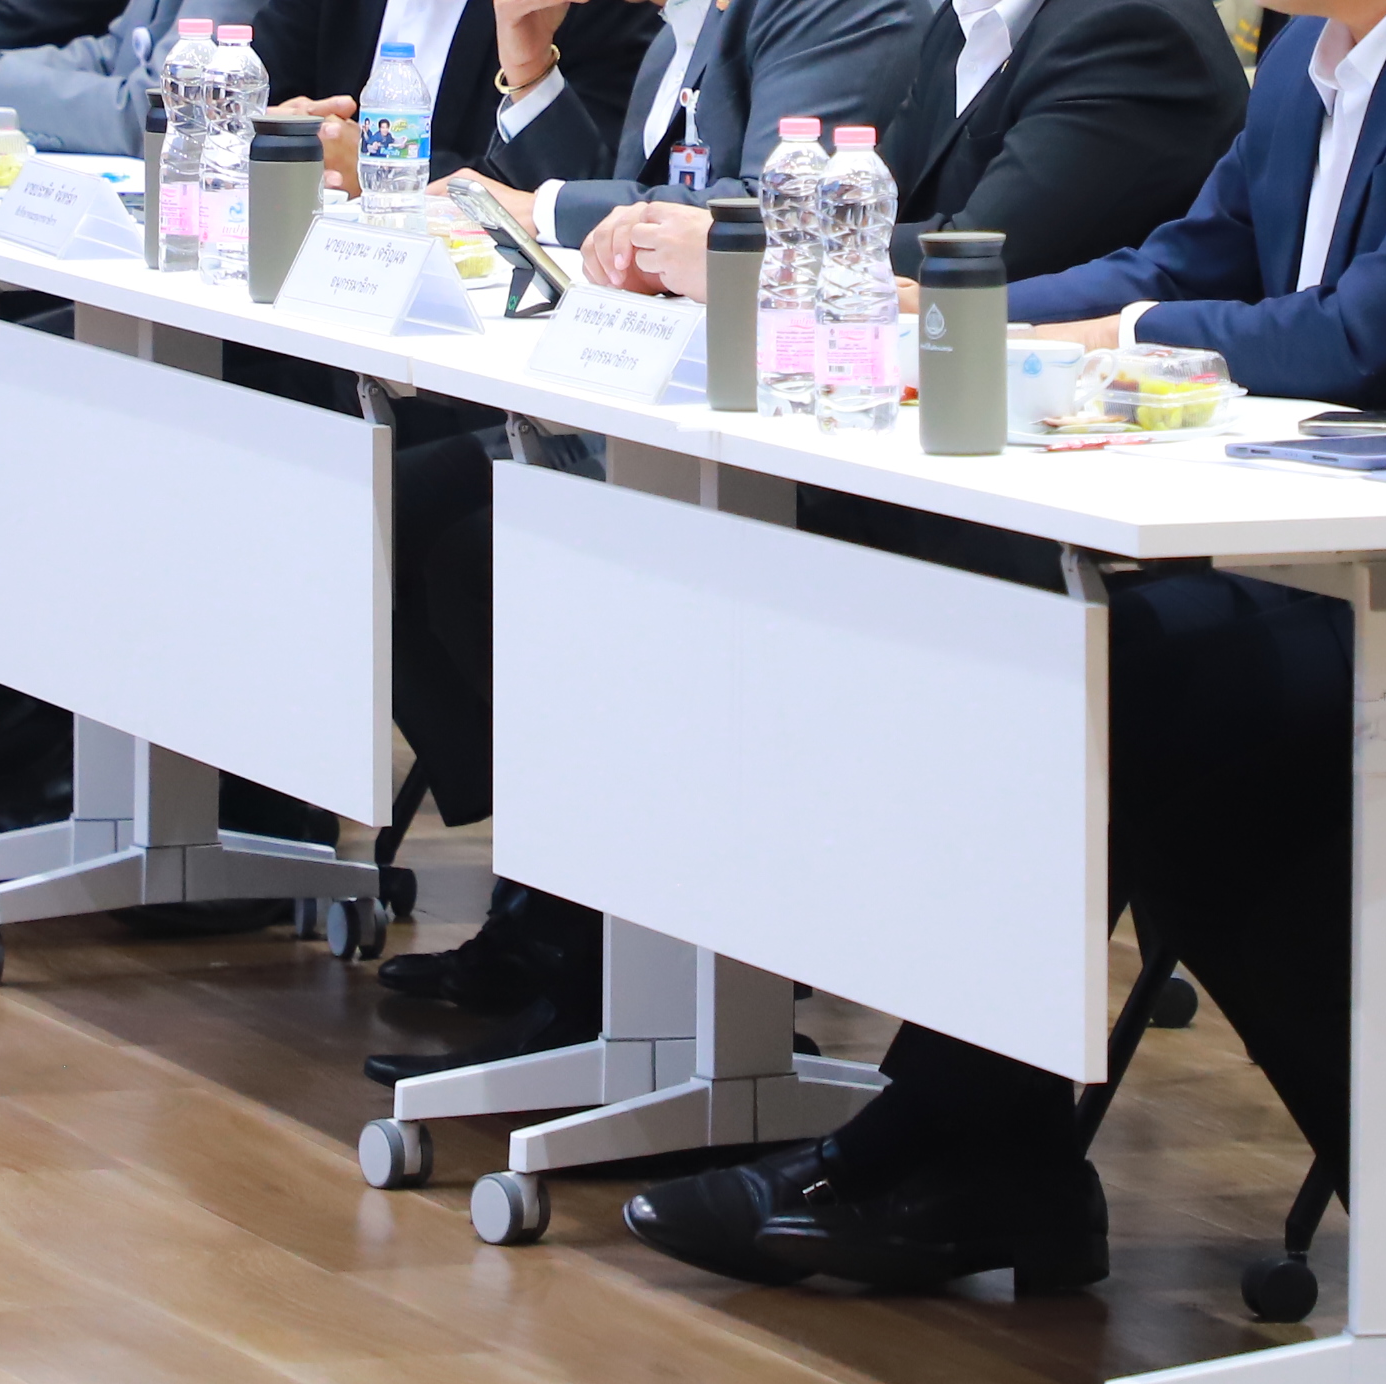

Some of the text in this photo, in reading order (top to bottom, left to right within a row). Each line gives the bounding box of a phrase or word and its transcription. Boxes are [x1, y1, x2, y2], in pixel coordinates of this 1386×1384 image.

[580, 347, 640, 369] อนุกรรมาธิการ
